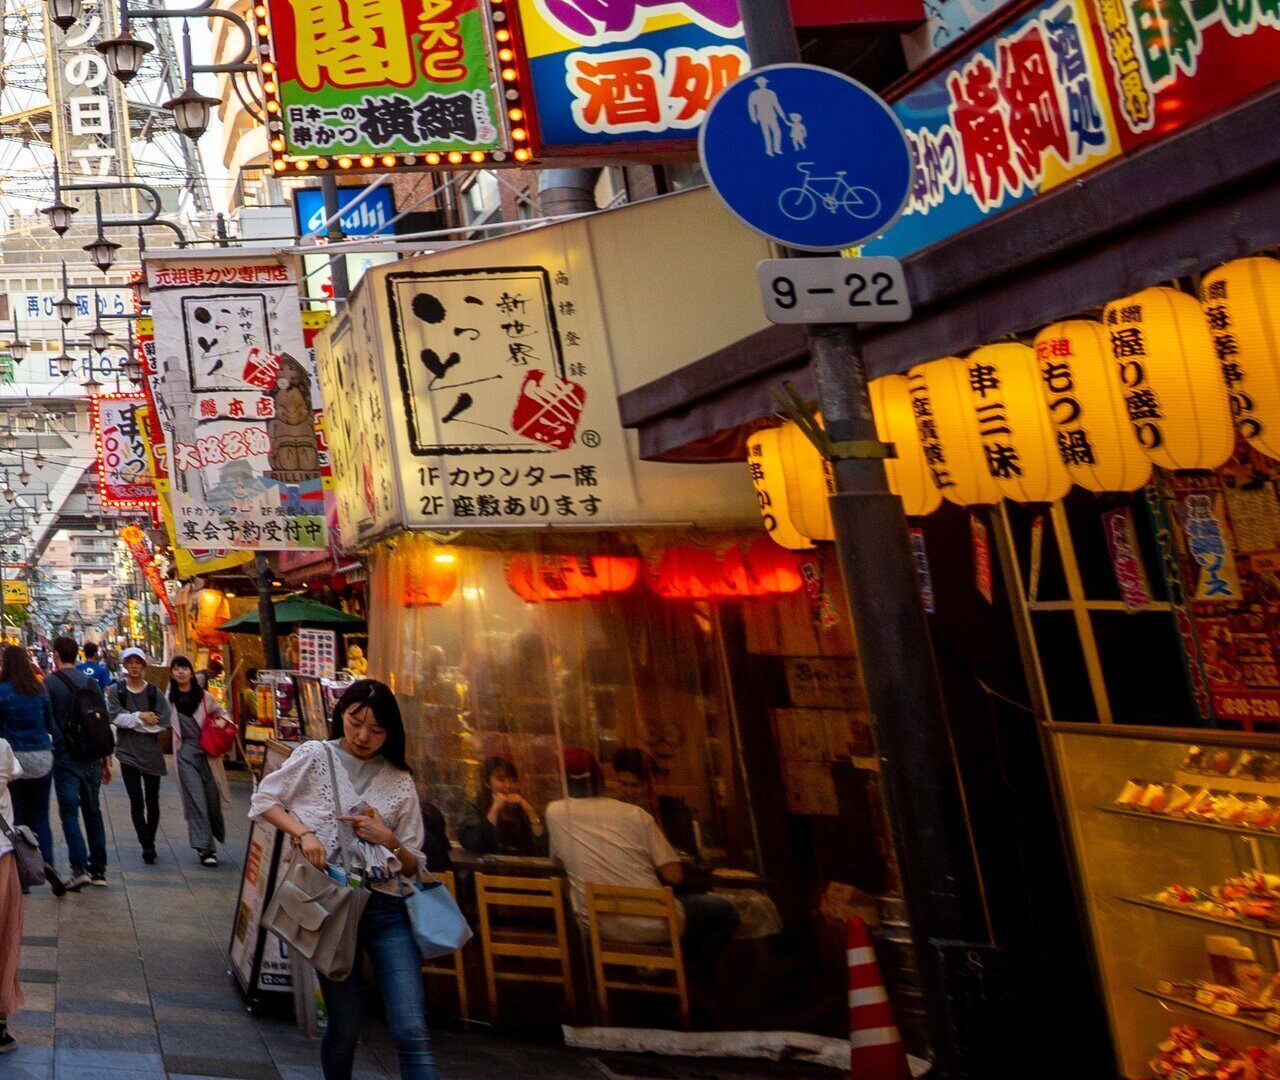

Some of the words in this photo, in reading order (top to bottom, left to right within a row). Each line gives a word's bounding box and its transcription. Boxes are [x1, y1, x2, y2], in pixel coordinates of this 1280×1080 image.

[360, 94, 478, 147] 横綱
[950, 24, 1072, 207] 横綱
[156, 265, 290, 285] 元祖串カツ専門店
[27, 294, 125, 318] 再び阪から
[496, 292, 541, 366] 新世界
[419, 467, 440, 488] 1F
[449, 464, 599, 488] カウンター席
[420, 496, 445, 518] 2F
[452, 494, 603, 517] 座敷あります
[181, 520, 324, 543] 宴会予約受付中
